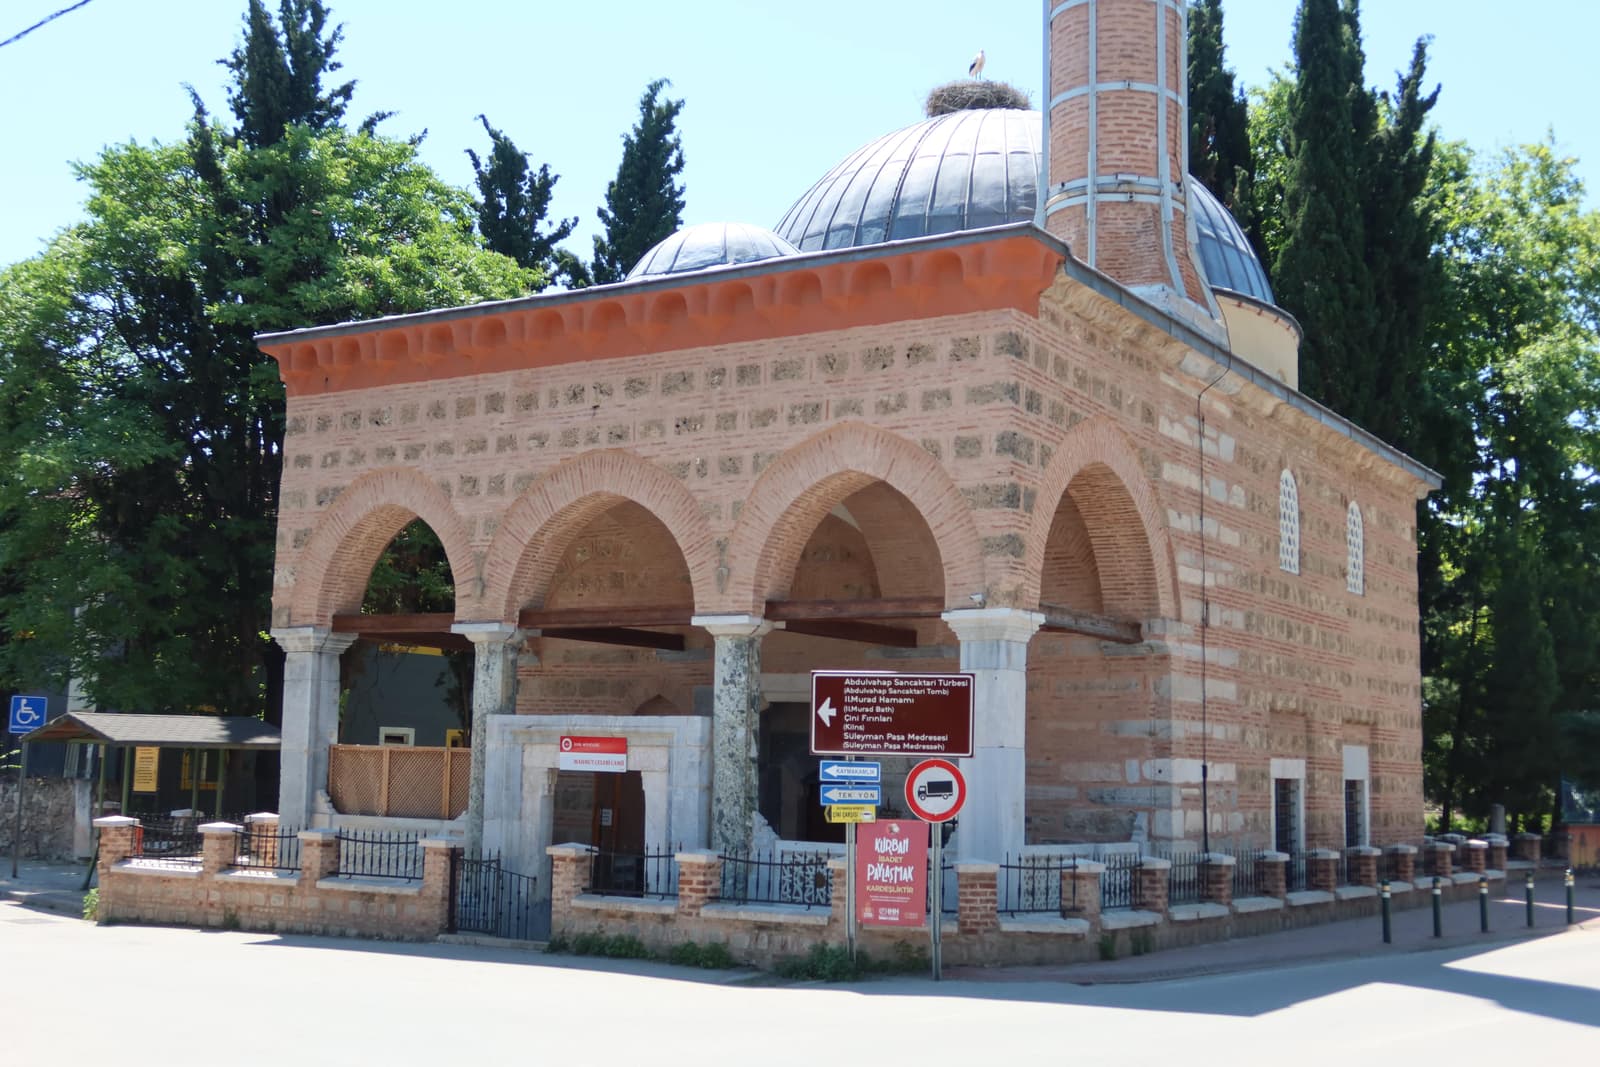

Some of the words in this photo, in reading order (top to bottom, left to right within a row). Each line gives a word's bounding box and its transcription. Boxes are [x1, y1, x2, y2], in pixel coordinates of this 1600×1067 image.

[844, 715, 860, 723] Çini
[843, 732, 885, 741] Süleyman
[886, 733, 905, 742] Paşa
[907, 733, 949, 742] Medresesi
[843, 742, 882, 750] (Süleyman
[875, 837, 910, 855] KURBAN
[867, 864, 914, 884] PAYLAŞMAK
